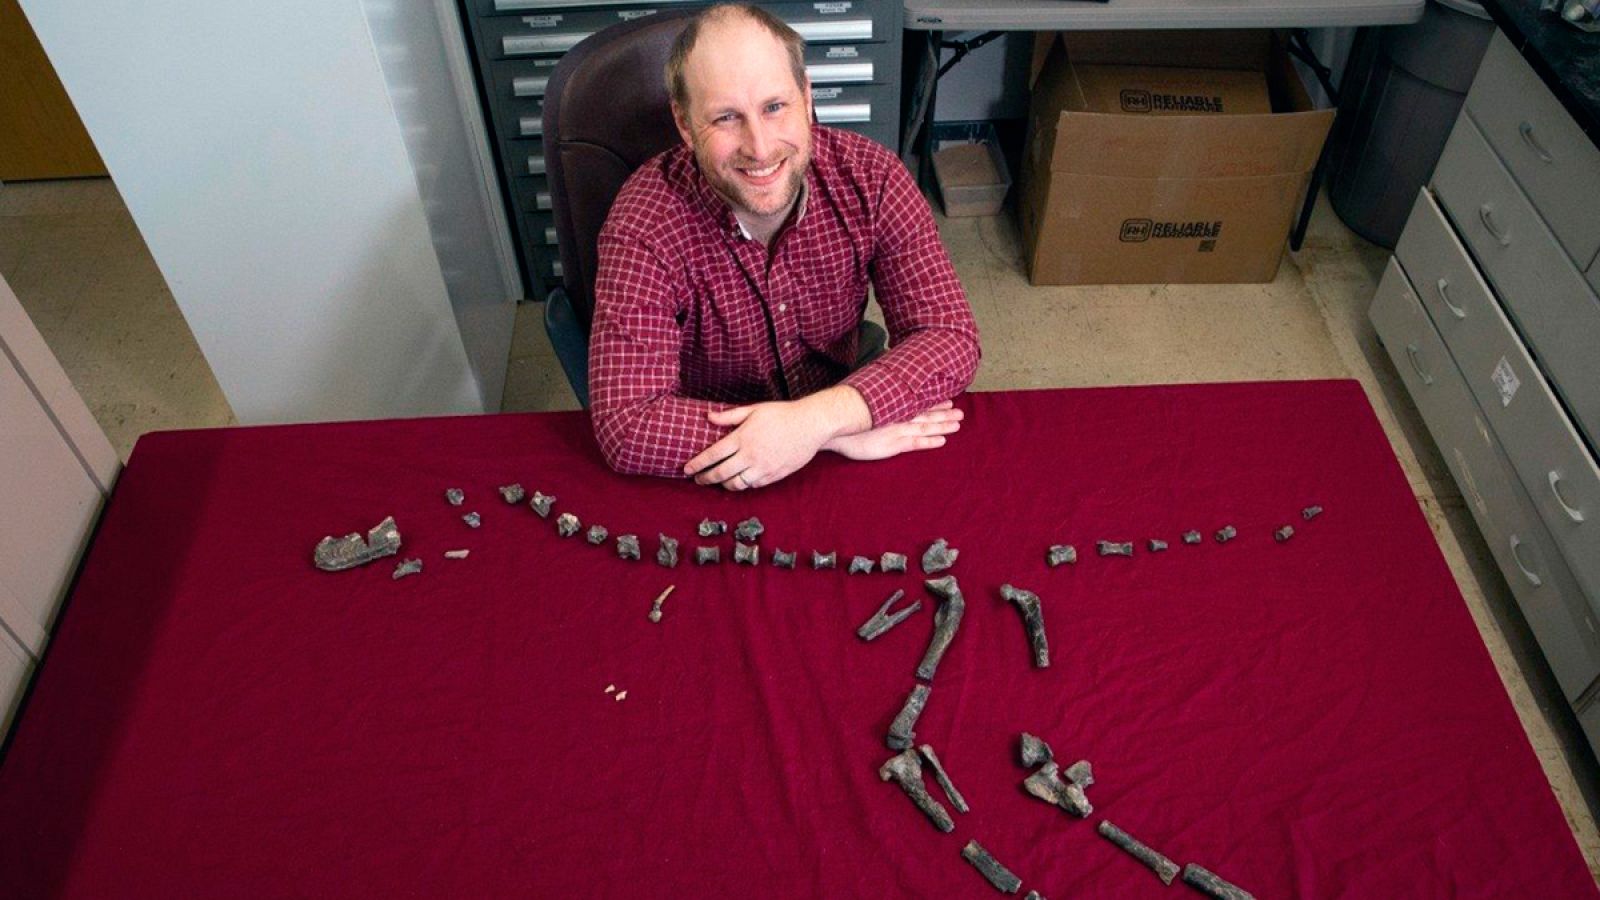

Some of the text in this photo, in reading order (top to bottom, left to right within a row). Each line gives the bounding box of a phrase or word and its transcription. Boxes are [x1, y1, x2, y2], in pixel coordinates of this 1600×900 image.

[1153, 95, 1222, 105] RELIABLE
[1127, 225, 1145, 235] RH
[1153, 221, 1222, 232] RELIABLE
